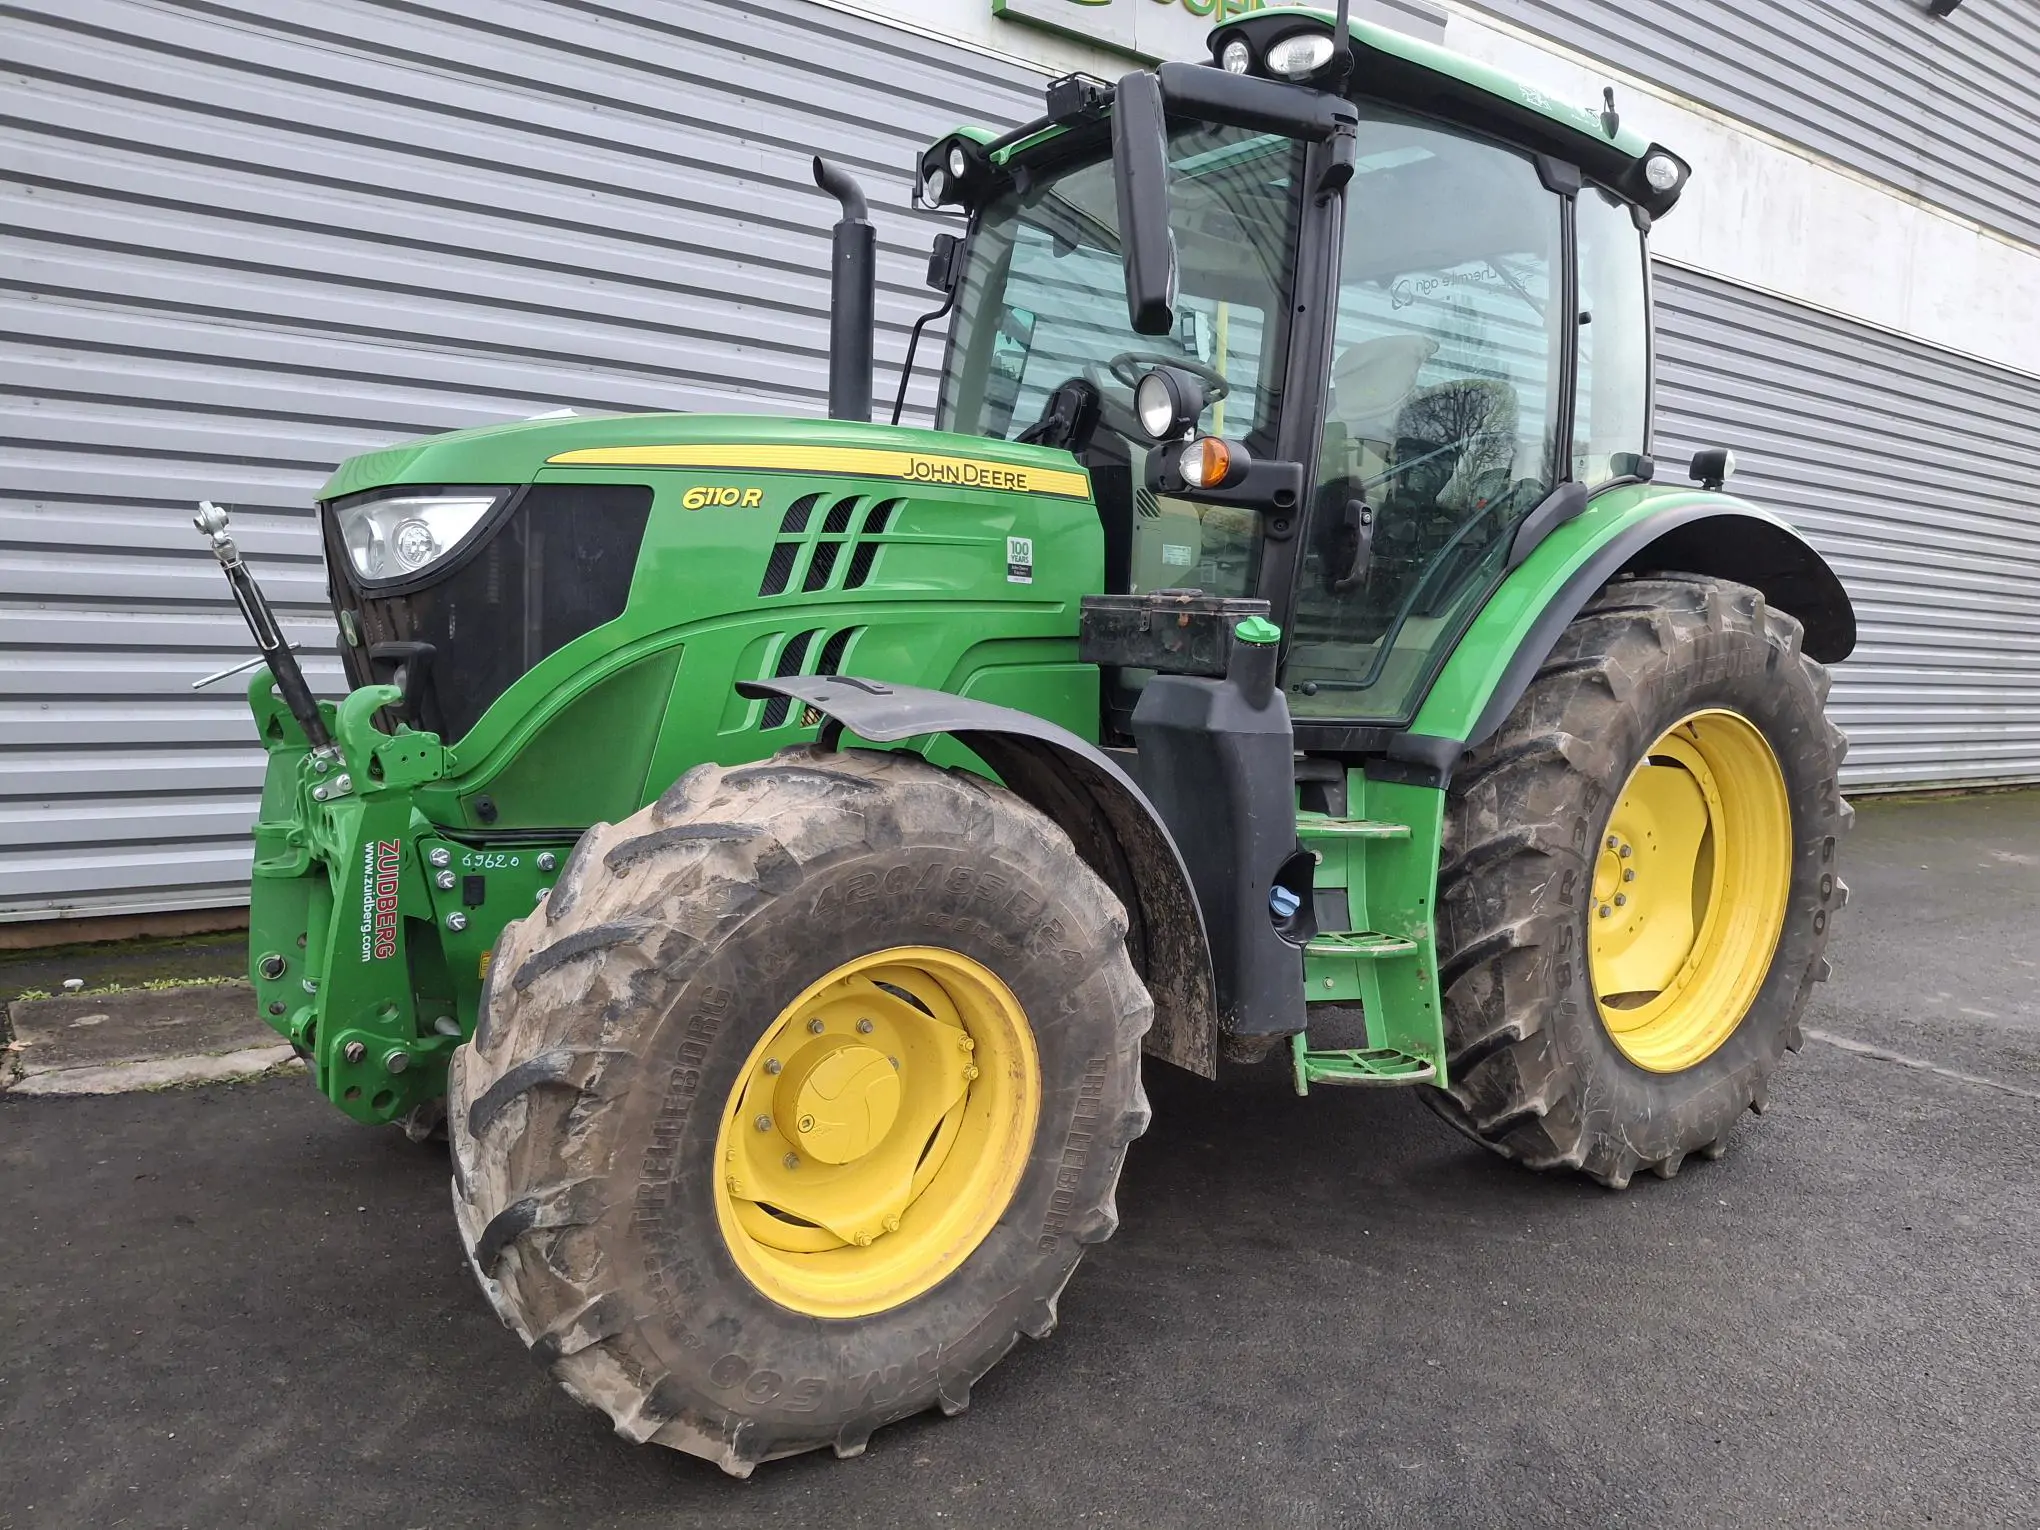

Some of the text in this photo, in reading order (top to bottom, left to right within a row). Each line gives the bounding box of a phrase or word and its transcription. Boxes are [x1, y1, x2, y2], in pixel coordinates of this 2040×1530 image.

[903, 456, 1028, 490] JOHN DEERE
[1010, 540, 1029, 556] 100
[1010, 555, 1029, 564] YEARS
[361, 841, 375, 963] www.zuidberg.com
[374, 839, 400, 960] ZUIDBERG
